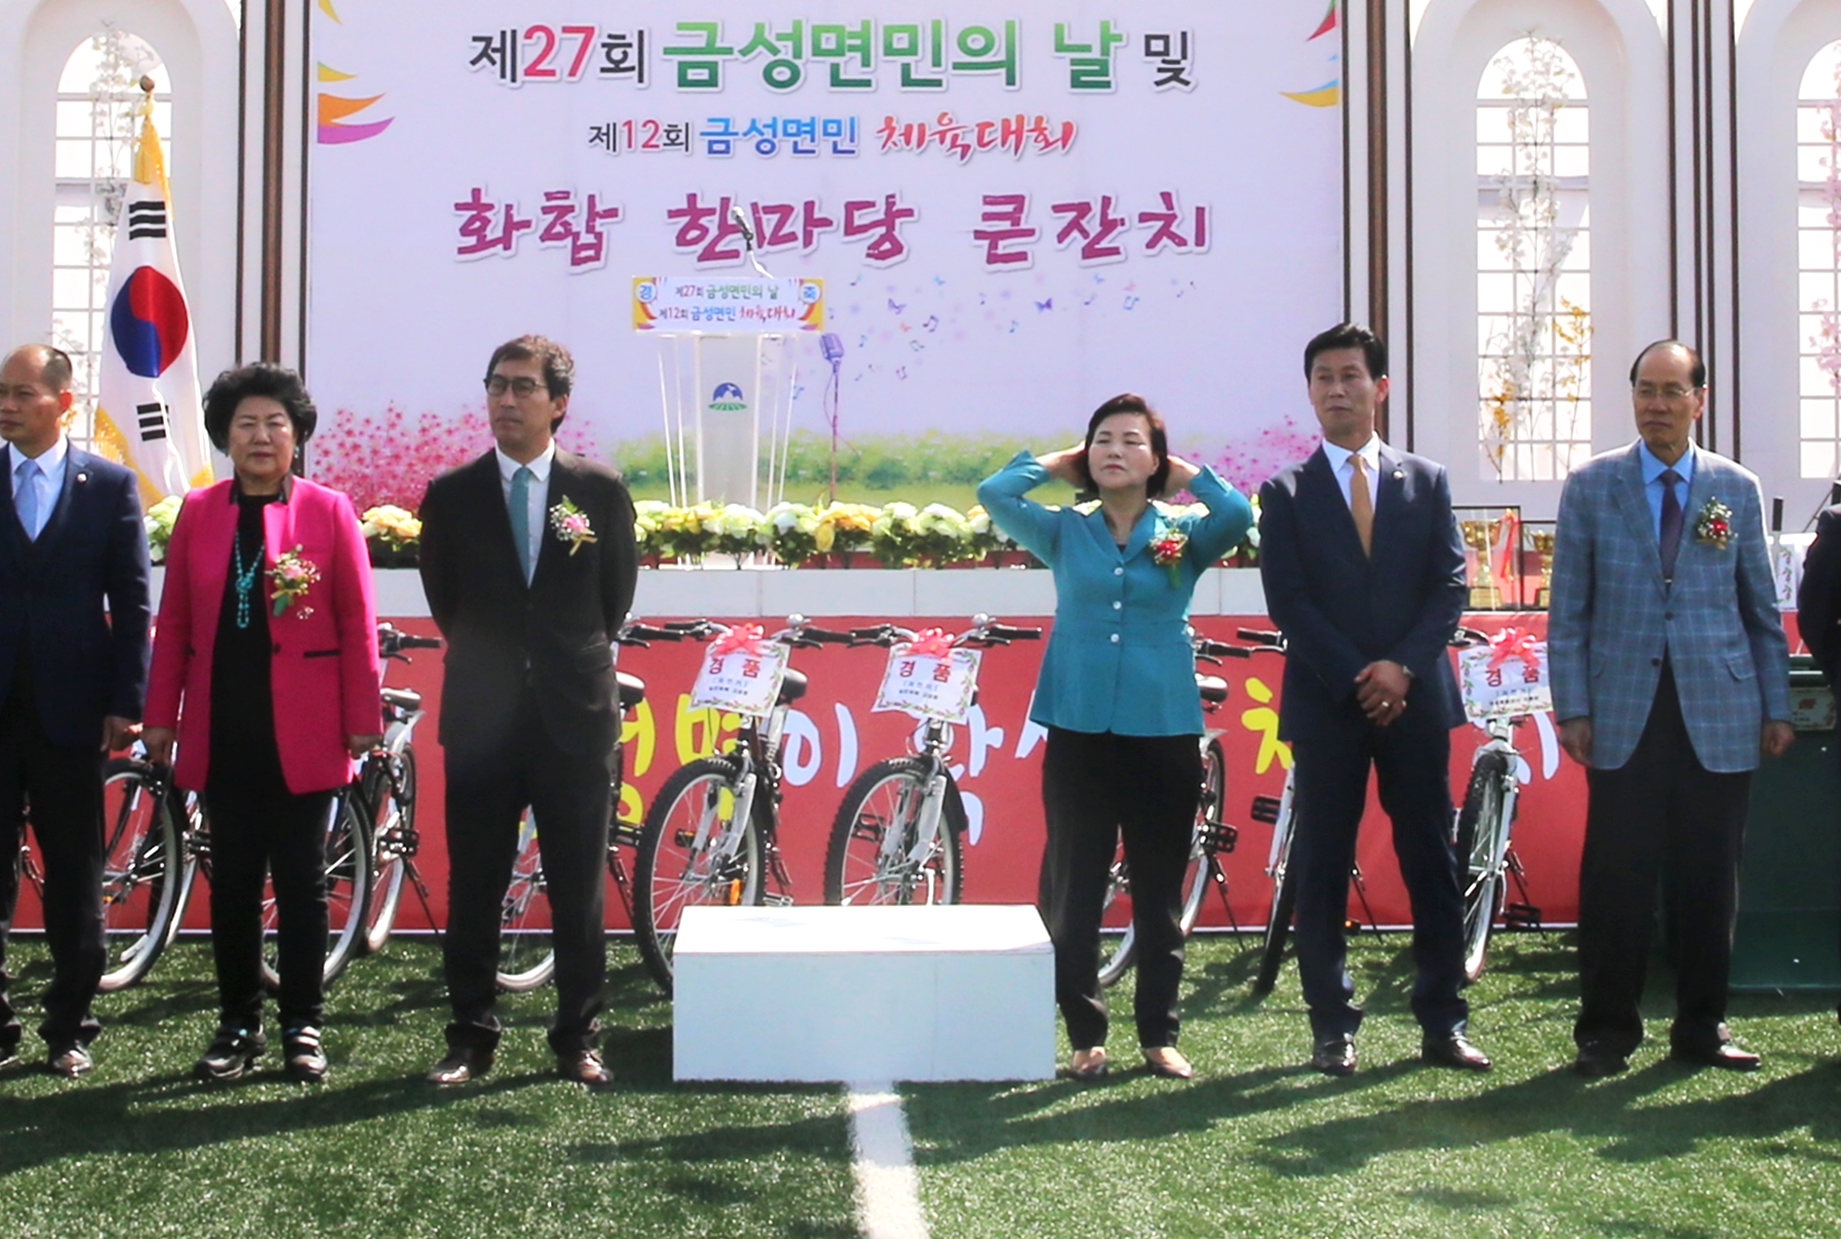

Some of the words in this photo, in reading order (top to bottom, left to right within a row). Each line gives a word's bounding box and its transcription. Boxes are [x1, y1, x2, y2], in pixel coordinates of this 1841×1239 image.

[469, 24, 645, 85] 제27회
[662, 18, 1017, 90] 금성면민의
[1054, 19, 1124, 90] 날
[1143, 30, 1192, 88] 및
[588, 119, 690, 153] 제12회
[699, 115, 856, 155] 금성면민
[875, 111, 1076, 163] 체육대회
[454, 187, 620, 267] 화합
[667, 193, 915, 263] 한마당
[675, 284, 704, 298] 제27회
[705, 283, 763, 300] 금성면민의
[767, 285, 780, 300] 날
